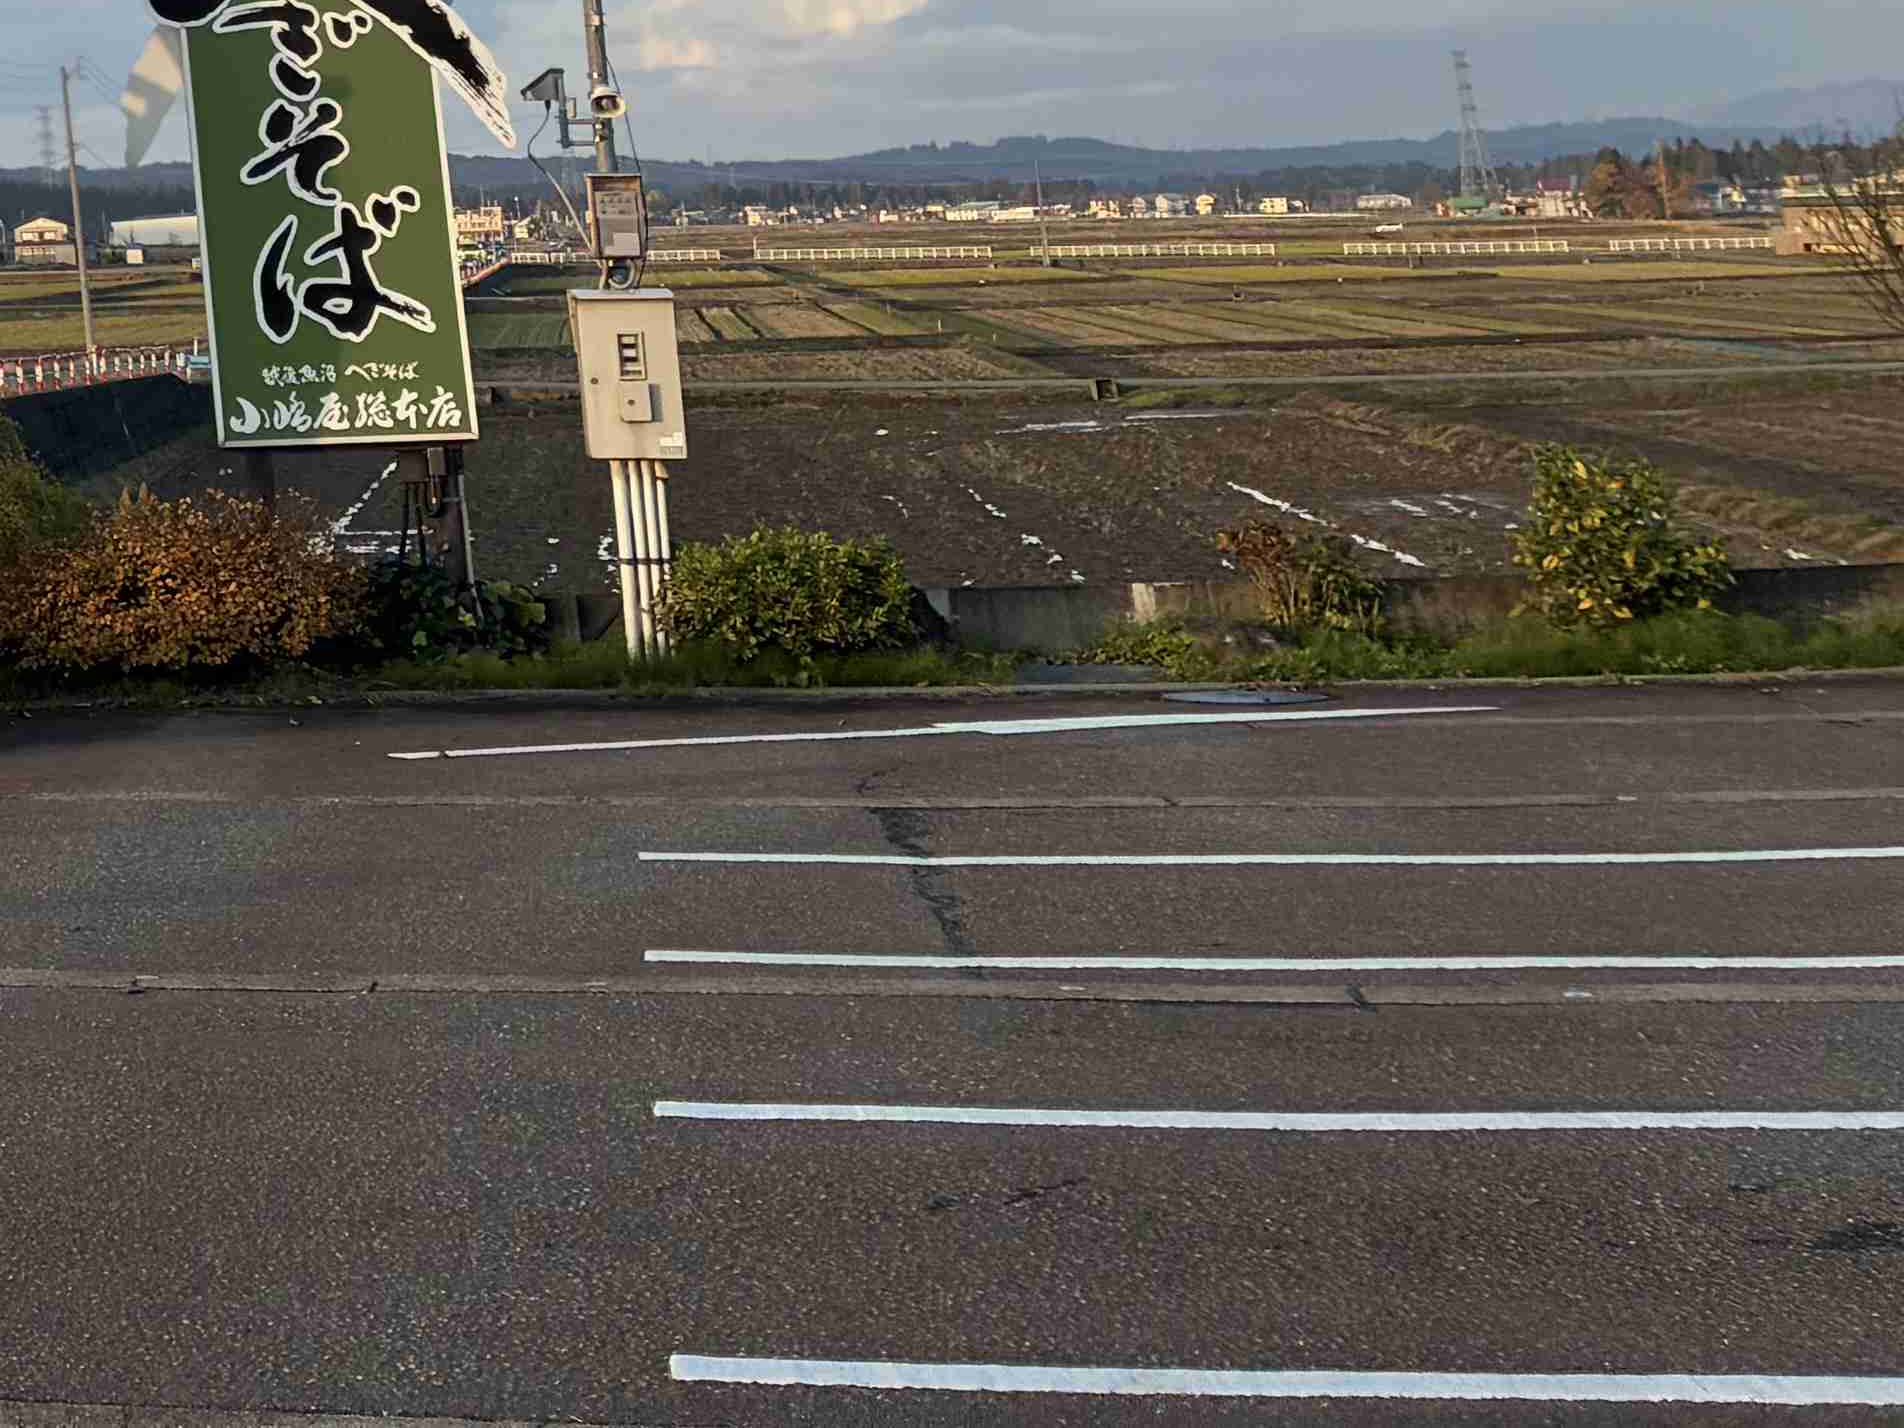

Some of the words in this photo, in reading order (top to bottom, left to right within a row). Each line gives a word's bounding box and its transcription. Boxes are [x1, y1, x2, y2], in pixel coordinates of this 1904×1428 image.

[344, 360, 421, 382] へぎそば
[229, 384, 464, 434] 小嶋屋総本店
